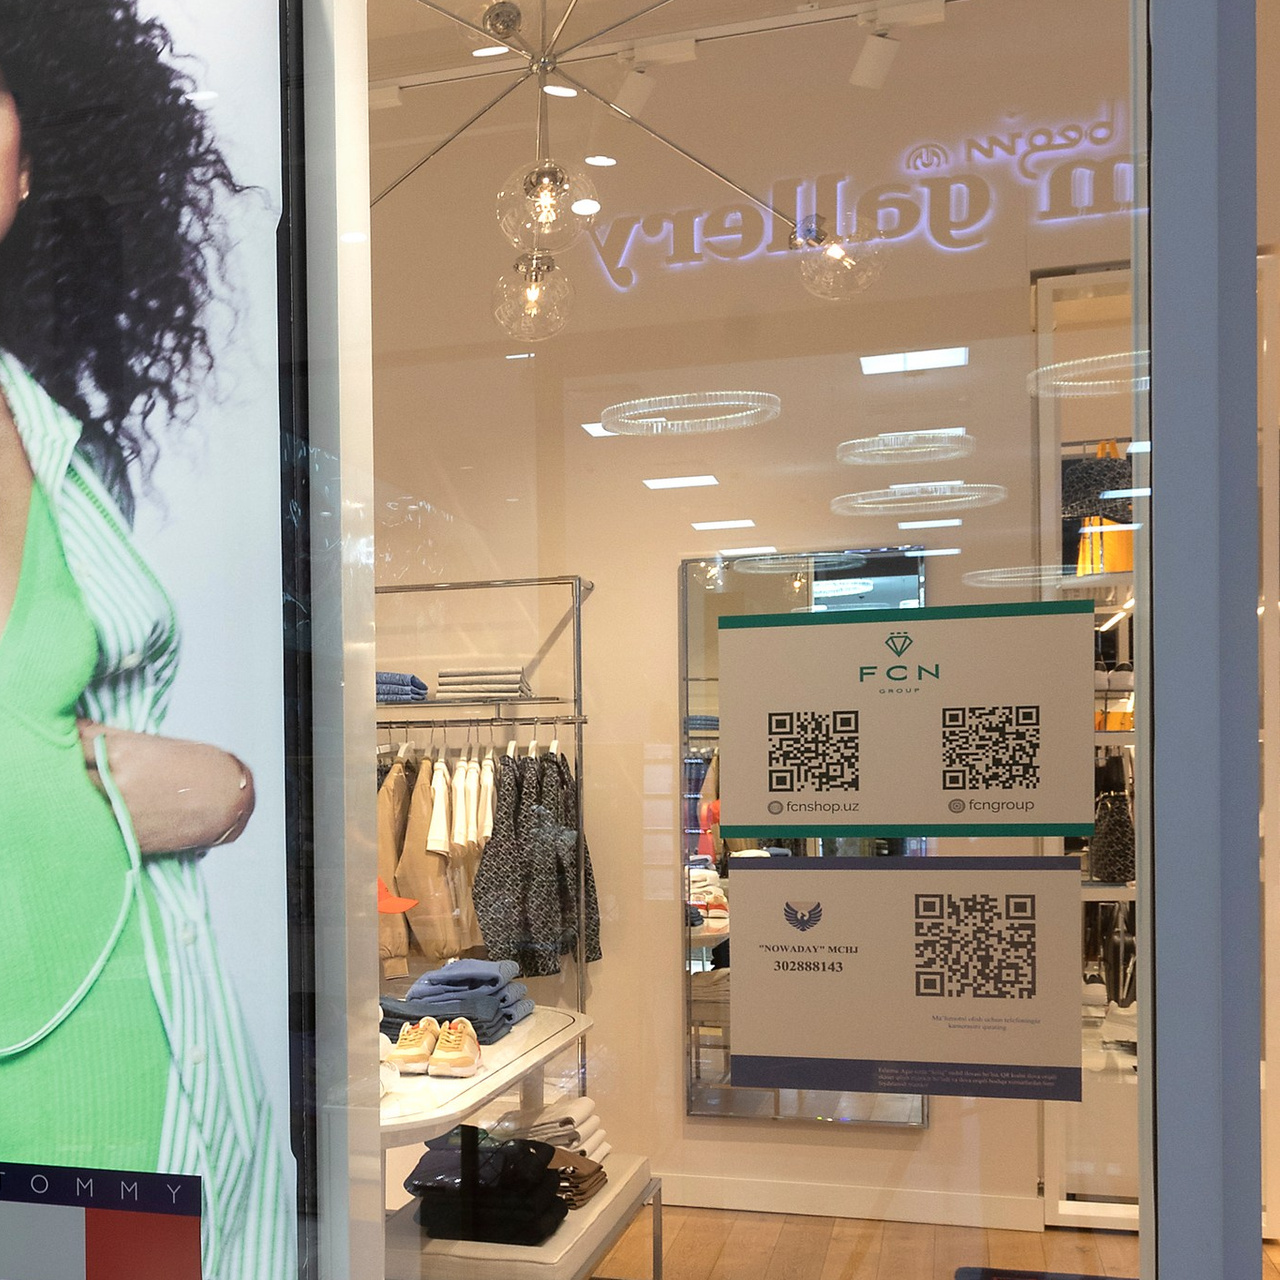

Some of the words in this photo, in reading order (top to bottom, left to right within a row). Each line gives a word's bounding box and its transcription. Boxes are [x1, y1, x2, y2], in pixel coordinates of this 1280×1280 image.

[859, 664, 940, 682] FCN
[786, 800, 860, 815] fcnshop.uz
[969, 799, 1035, 813] fcngroup
[759, 944, 825, 954] "NOWADAY"
[828, 946, 859, 954] MCHJ
[773, 960, 844, 973] 302888143
